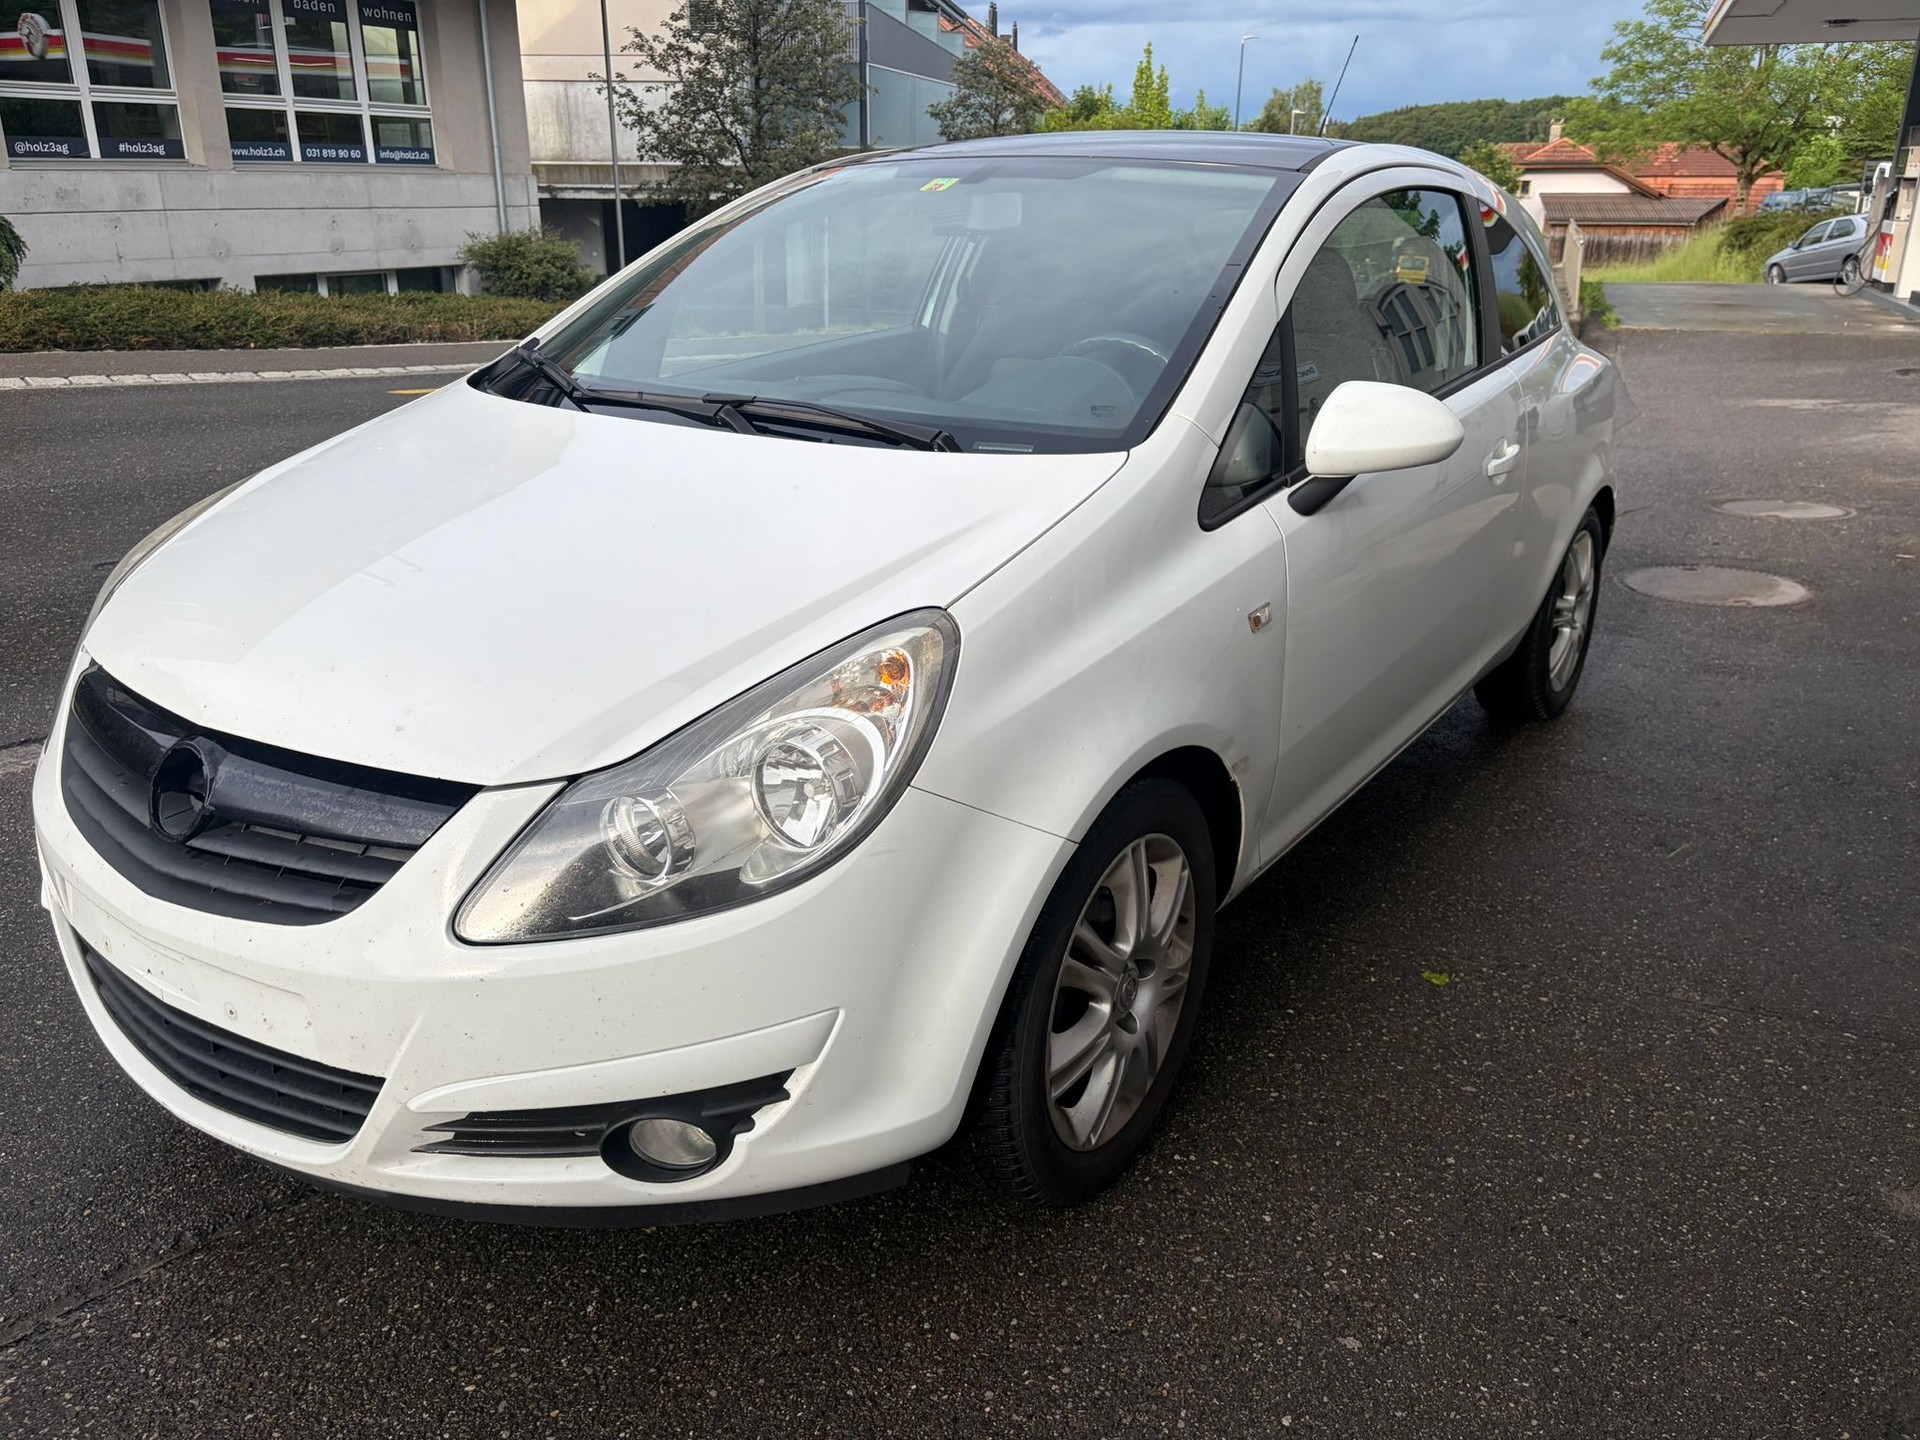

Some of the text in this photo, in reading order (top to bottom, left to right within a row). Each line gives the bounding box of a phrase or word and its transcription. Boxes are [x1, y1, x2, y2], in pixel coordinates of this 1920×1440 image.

[293, 0, 335, 13] baden
[362, 7, 412, 22] wohnen
[15, 141, 69, 154] @holz3ag
[119, 142, 165, 155] #holz3ag
[306, 148, 361, 159] 031 819 90 60
[380, 150, 429, 160] info@holz3.ch
